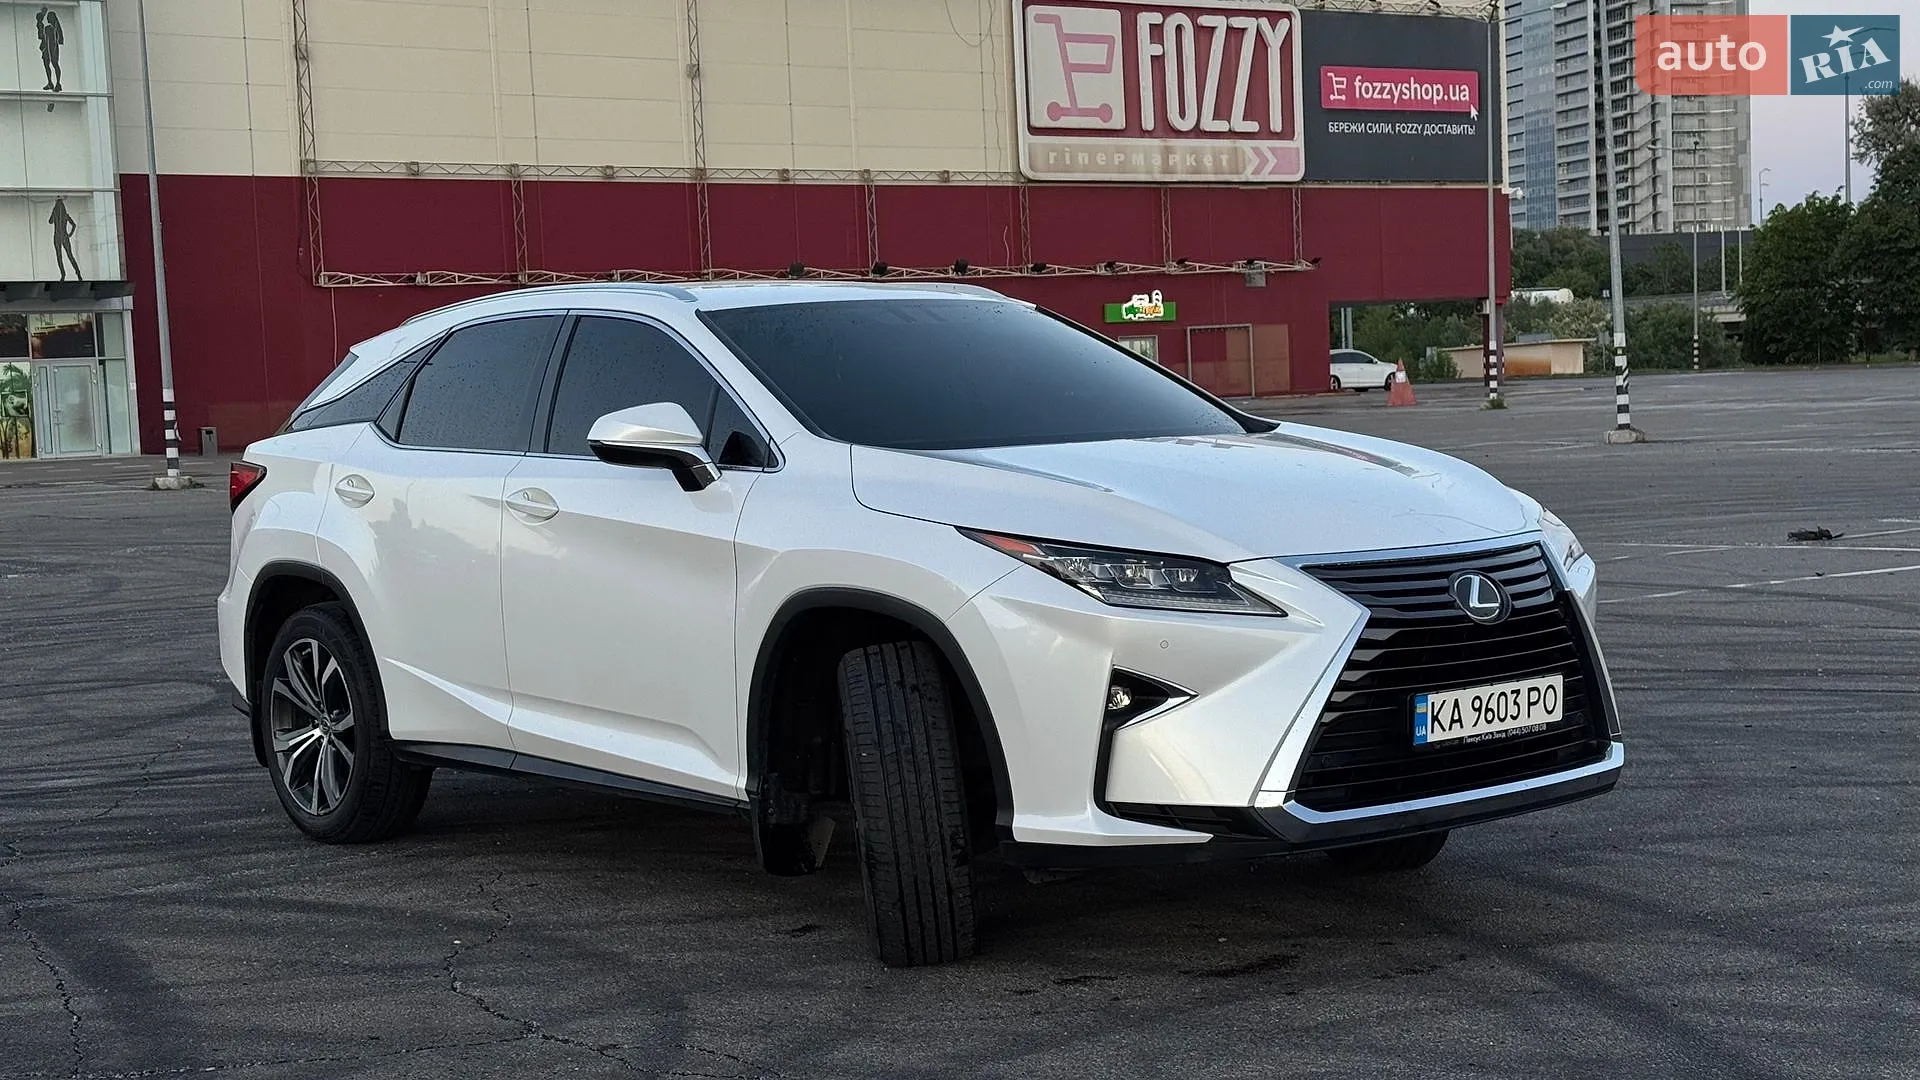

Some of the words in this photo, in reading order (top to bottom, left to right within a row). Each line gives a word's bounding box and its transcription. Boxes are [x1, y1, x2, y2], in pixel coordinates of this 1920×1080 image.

[1137, 12, 1290, 133] FOZZY
[1354, 75, 1470, 105] fozzyshop.ua
[1328, 121, 1365, 134] БЕРЕЖИ
[1395, 123, 1422, 135] FOZZY
[1423, 123, 1476, 137] ДОСТАВИТЬ!
[1430, 699, 1464, 734] KA
[1471, 688, 1521, 729] 9603
[1527, 684, 1558, 719] PO
[1415, 725, 1427, 737] UA
